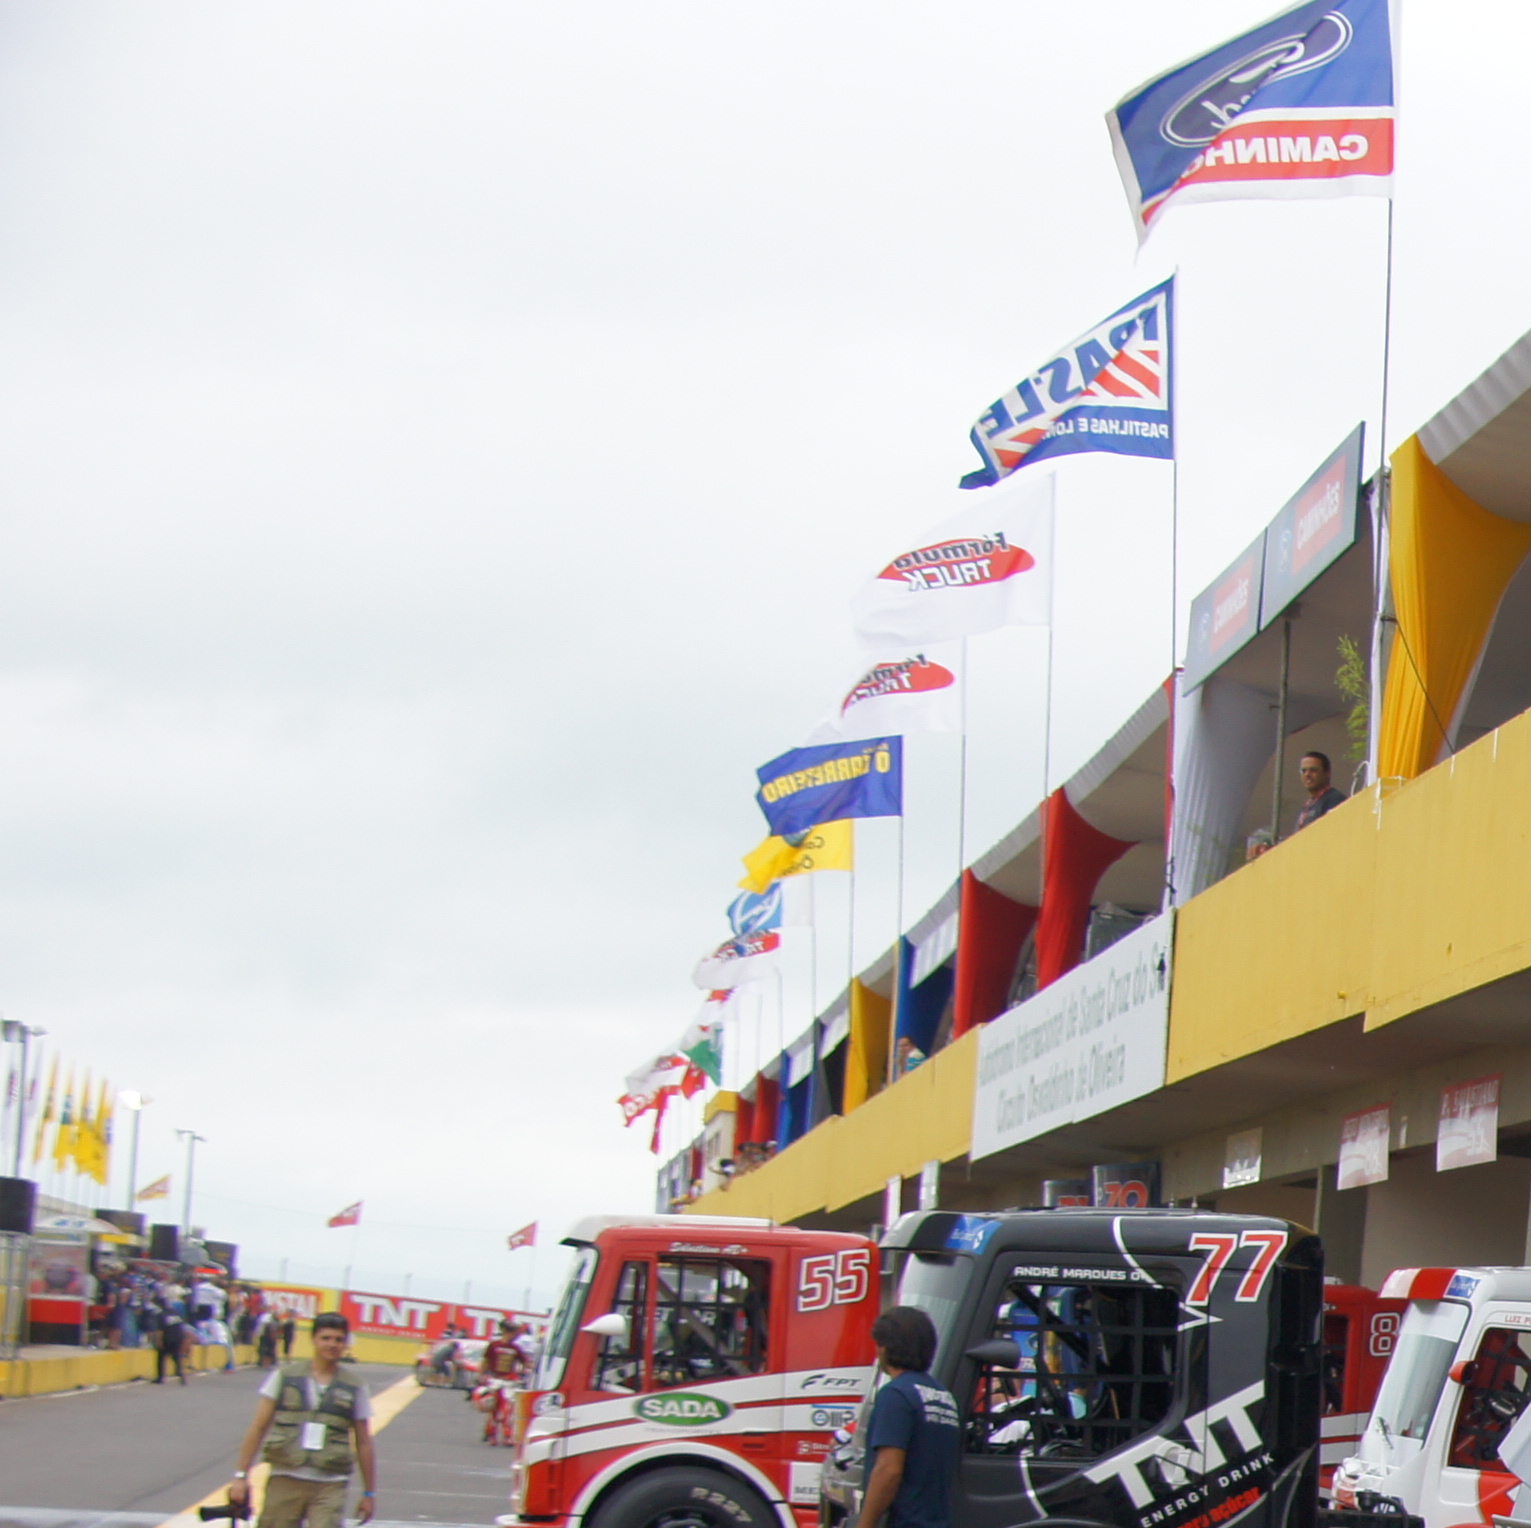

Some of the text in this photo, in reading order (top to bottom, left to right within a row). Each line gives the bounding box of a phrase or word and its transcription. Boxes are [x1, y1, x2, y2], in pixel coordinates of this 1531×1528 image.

[797, 1248, 871, 1312] 55
[1014, 1265, 1059, 1278] ANDRÉ
[1063, 1268, 1126, 1280] MARQUES
[1184, 1230, 1288, 1306] 77
[351, 1294, 442, 1329] TNT
[463, 1307, 550, 1337] TT
[1504, 1315, 1522, 1324] LUIZ
[822, 1377, 863, 1387] FPT
[642, 1399, 722, 1418] SADA
[1082, 1379, 1266, 1510] TNT
[1140, 1453, 1275, 1528] ENERGY DRINK
